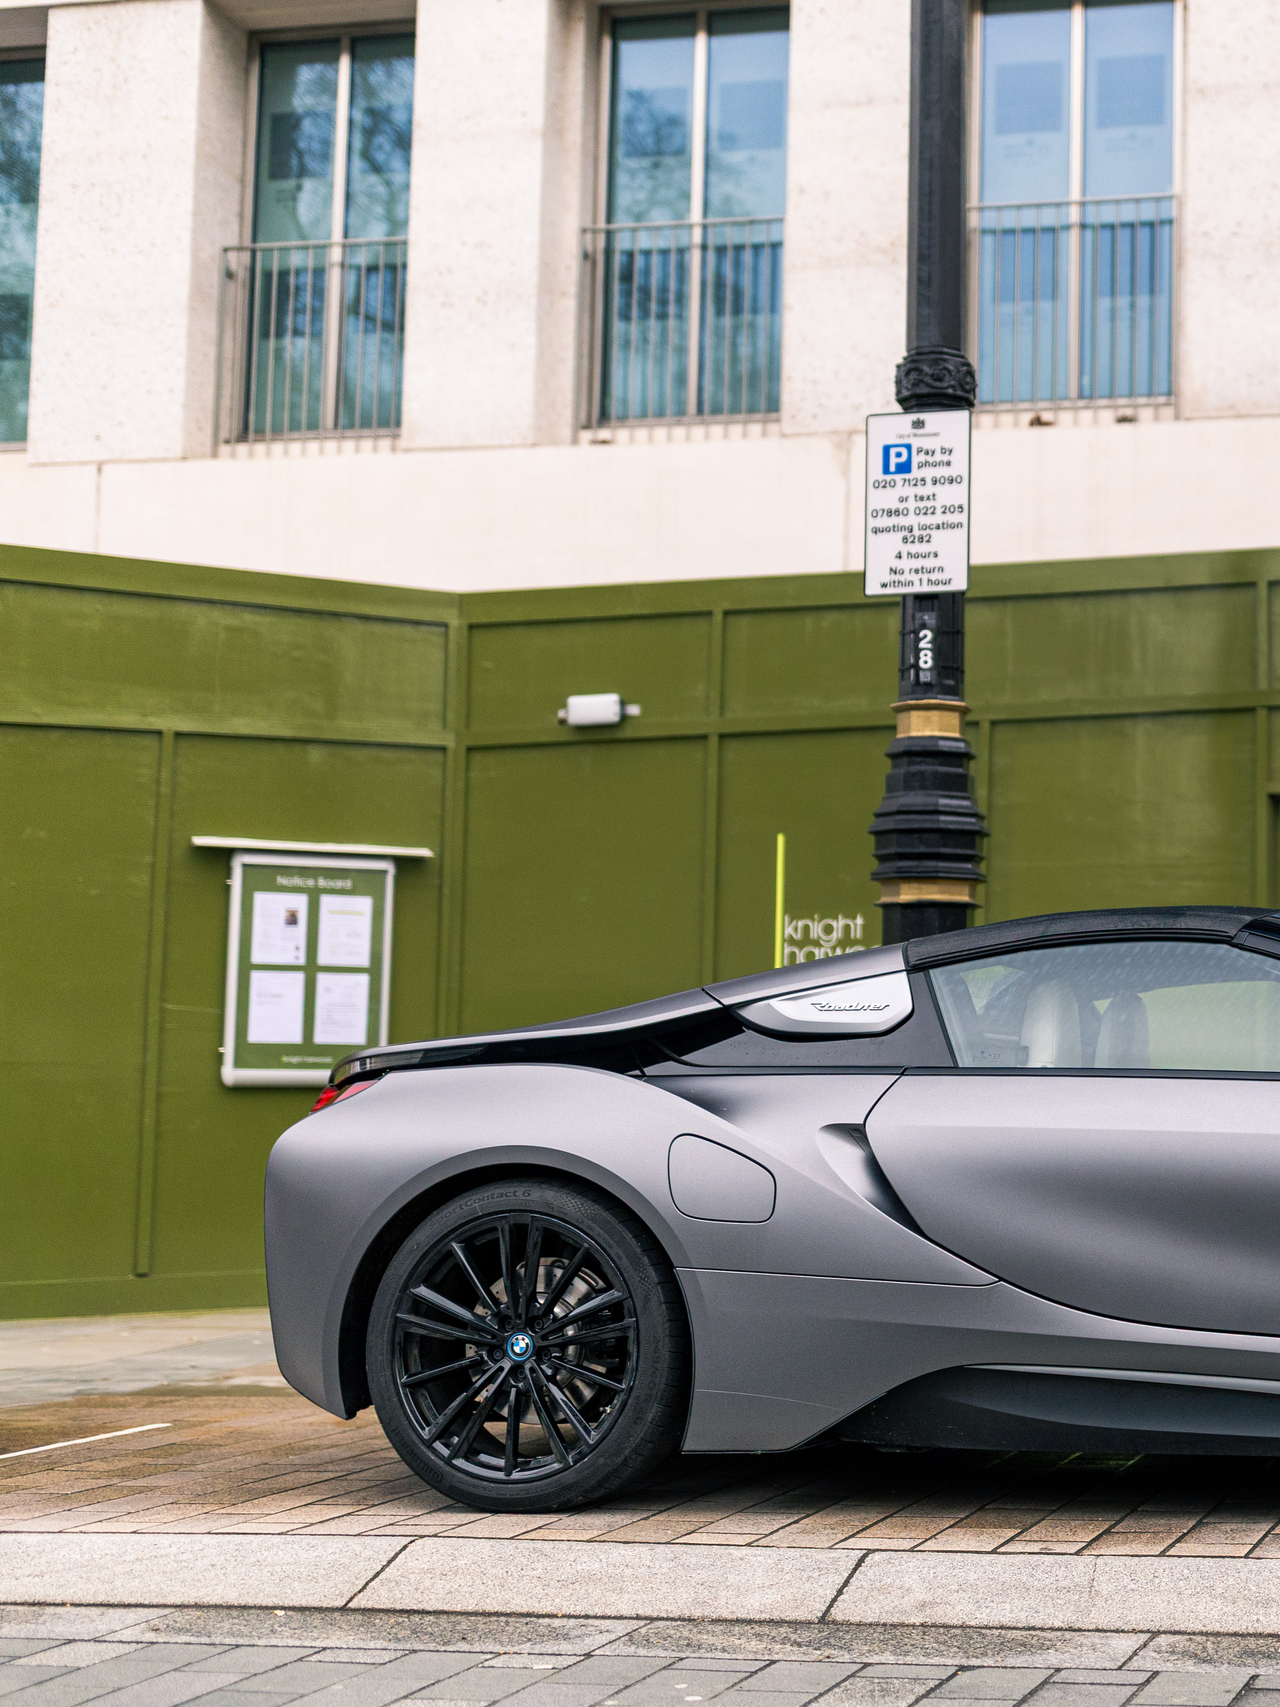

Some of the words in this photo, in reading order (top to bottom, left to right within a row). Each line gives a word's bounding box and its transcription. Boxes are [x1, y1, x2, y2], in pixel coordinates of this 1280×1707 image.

[916, 447, 936, 457] Pay
[940, 445, 953, 456] by
[889, 446, 909, 473] P
[917, 459, 951, 470] phone
[873, 479, 897, 489] 020
[900, 477, 926, 487] 7125
[931, 475, 963, 485] 9090
[898, 495, 909, 503] or
[914, 492, 936, 502] text
[871, 507, 909, 518] 07860
[914, 506, 936, 516] 022
[941, 504, 964, 514] 205
[871, 524, 913, 535] quoting
[918, 521, 963, 531] location
[902, 534, 931, 544] 6282
[895, 551, 902, 560] 4
[907, 550, 939, 560] hours
[889, 567, 904, 576] No
[909, 565, 944, 575] return
[880, 578, 914, 588] within
[918, 577, 923, 587] 1
[927, 577, 953, 587] hour
[277, 875, 315, 888] Notice
[317, 877, 352, 890] Board
[784, 913, 864, 946] knight
[811, 1001, 890, 1012] Roadster
[522, 1189, 532, 1198] 6
